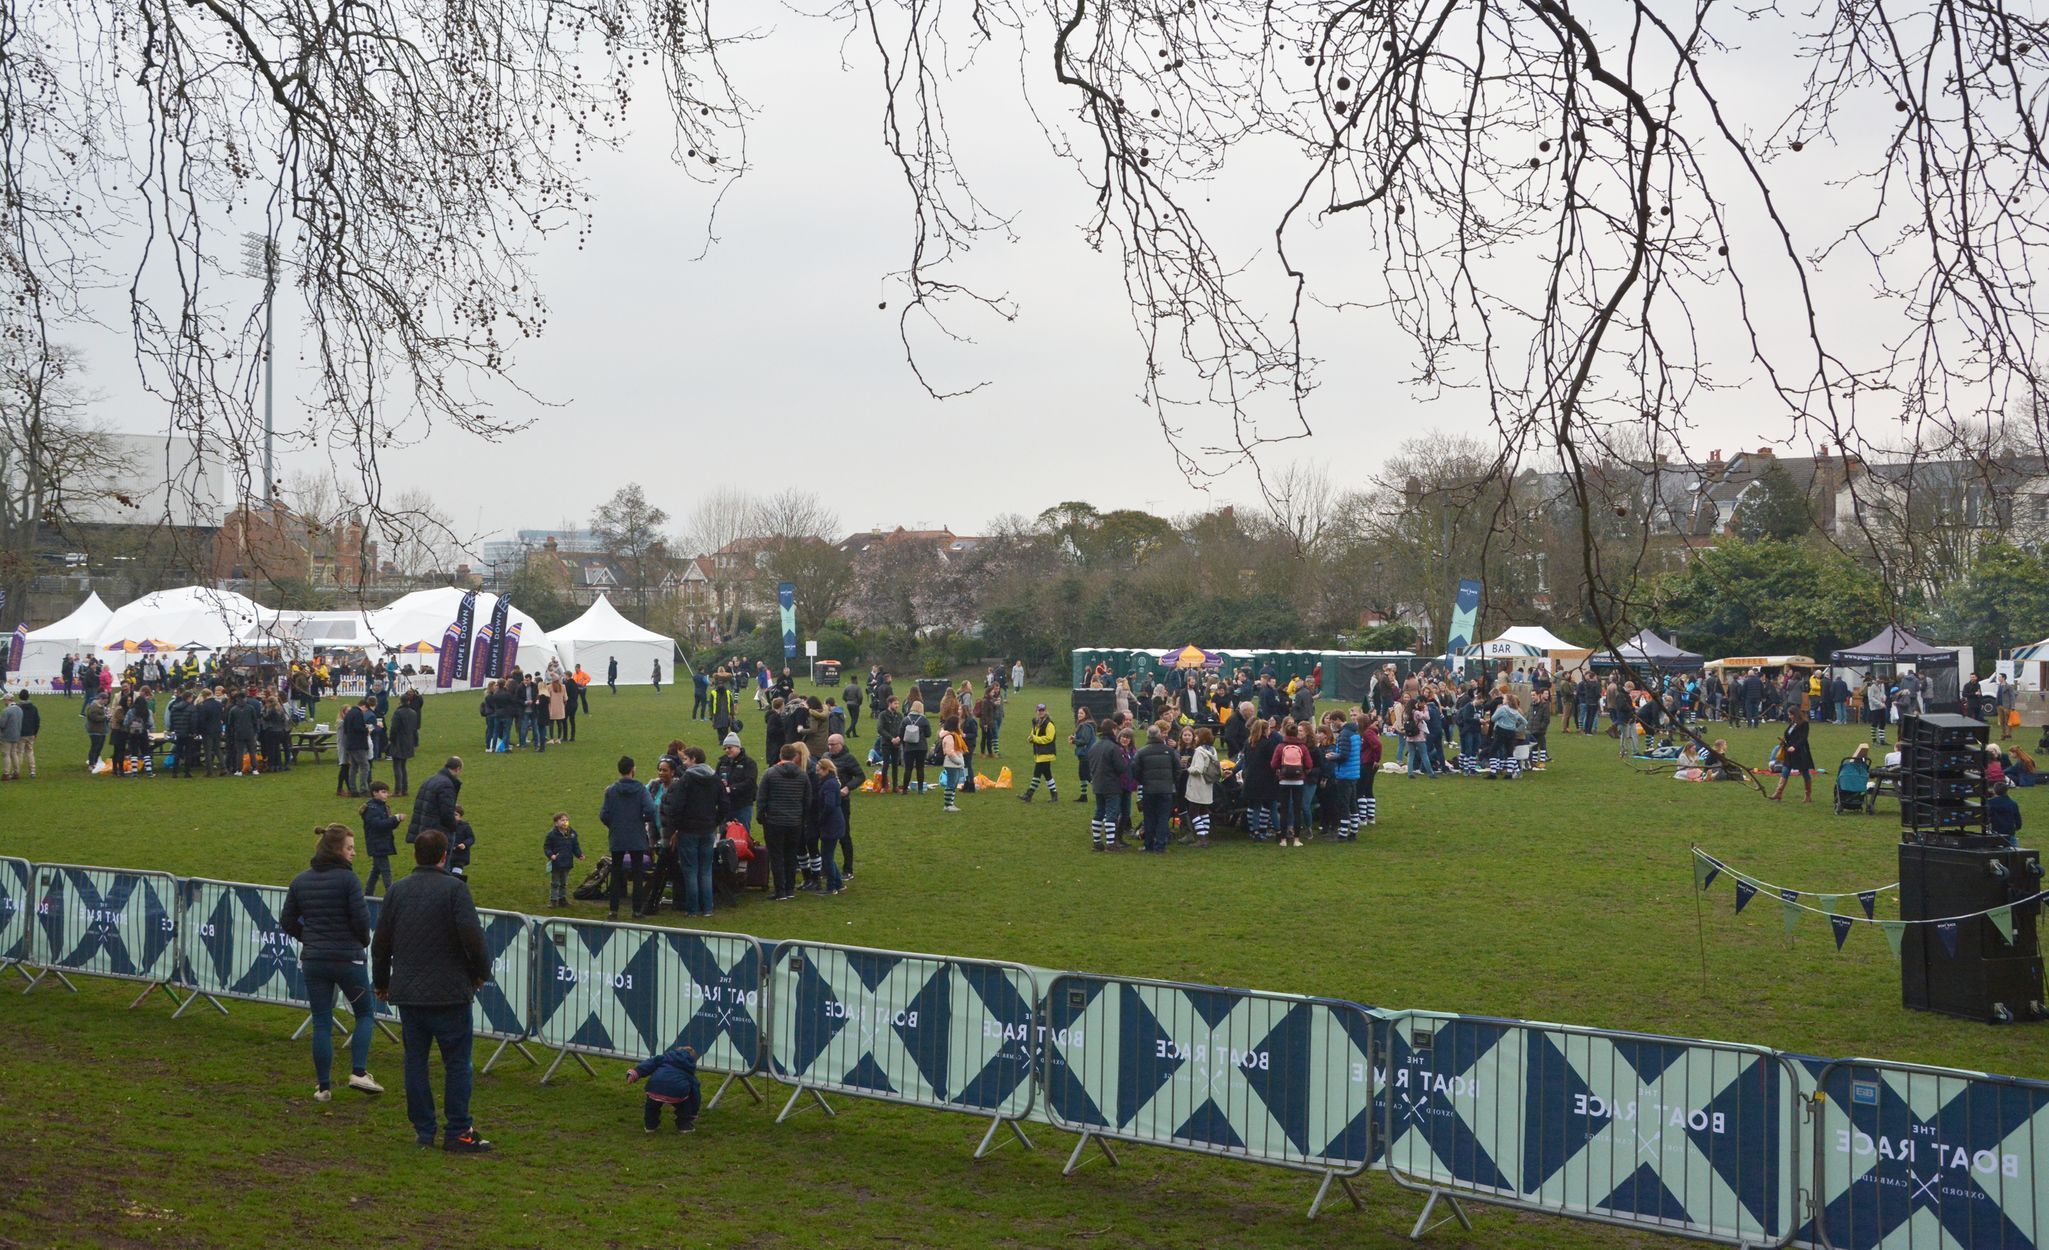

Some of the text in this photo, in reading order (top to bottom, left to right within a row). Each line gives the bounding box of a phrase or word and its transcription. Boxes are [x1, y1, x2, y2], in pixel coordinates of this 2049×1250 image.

[456, 609, 469, 678] CHAPEL DOWN
[490, 611, 502, 677] CHAPEL DOWN
[1492, 643, 1511, 653] BAR
